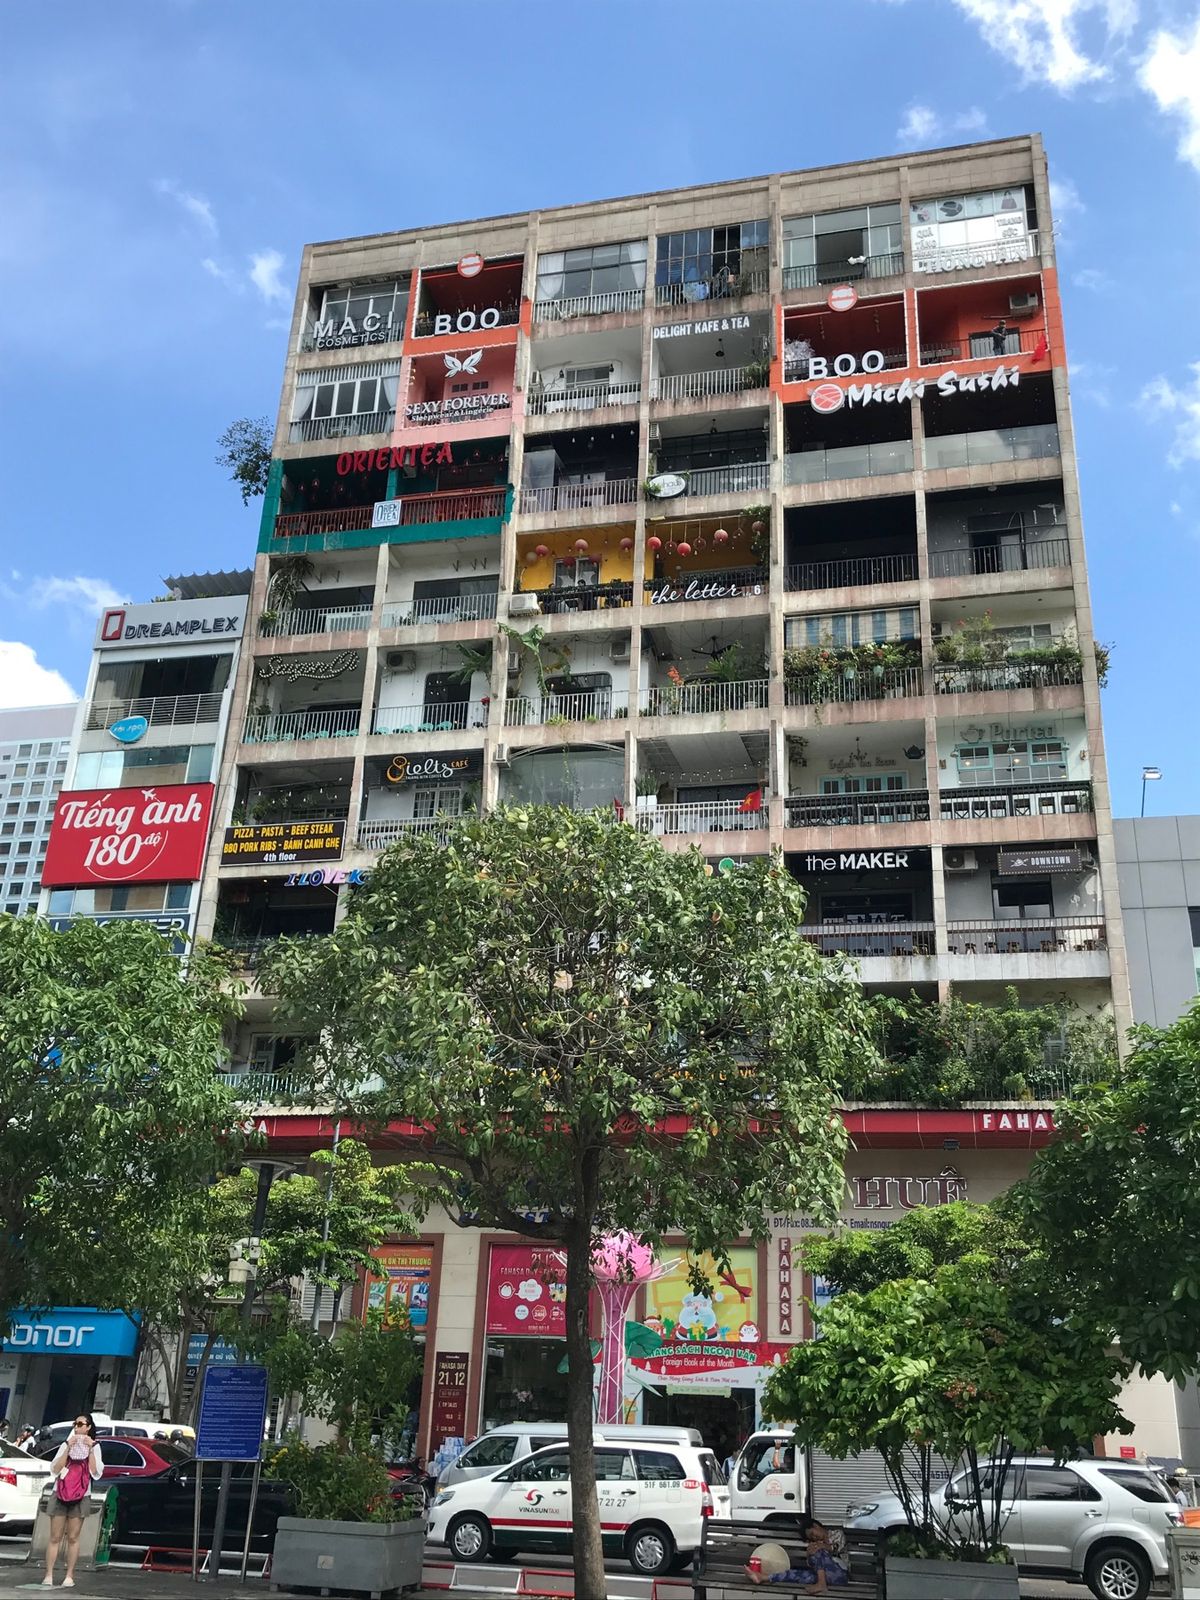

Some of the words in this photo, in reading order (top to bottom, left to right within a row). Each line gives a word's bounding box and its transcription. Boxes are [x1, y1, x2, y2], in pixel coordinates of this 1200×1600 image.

[313, 311, 393, 339] MACI
[434, 308, 500, 335] BOO
[654, 323, 692, 339] DELIGHT
[695, 320, 719, 334] KAFE
[722, 319, 729, 331] &
[731, 316, 750, 329] TEA
[317, 331, 385, 348] COSMETICS
[809, 350, 884, 380] BOO
[848, 377, 925, 408] Michi
[937, 365, 1020, 397] Sushi
[406, 400, 441, 416] SEXY
[444, 392, 509, 412] FOREVER
[336, 441, 454, 476] ORIENTEA
[651, 584, 682, 605] the
[685, 580, 741, 600] letter
[125, 616, 239, 640] DREAMPLEX
[60, 793, 136, 835] Tiếng
[233, 828, 254, 839] PIZZA
[261, 826, 284, 838] PASTA
[291, 825, 310, 836] BEEF
[310, 823, 334, 834] STEAK
[83, 833, 142, 867] 180
[141, 832, 162, 847] độ
[223, 842, 238, 854] BBQ
[239, 841, 259, 853] PORK
[260, 840, 277, 851] RIBS
[283, 837, 303, 851] BÁNH
[304, 838, 324, 849] CANH
[263, 852, 277, 862] 4th
[279, 852, 297, 862] floor
[805, 855, 836, 871] the
[840, 852, 909, 870] MAKER
[1031, 856, 1071, 866] DOWNTOWN
[983, 1113, 1062, 1130] FAHA
[780, 1239, 790, 1332] FAHASA
[3, 1325, 95, 1347] onor
[675, 1342, 701, 1354] SÁCH
[703, 1346, 734, 1359] NGOẠI
[662, 1358, 682, 1368] Foreign
[684, 1358, 698, 1366] Book
[699, 1358, 705, 1366] of
[707, 1358, 716, 1367] the
[717, 1358, 735, 1367] Month
[438, 1371, 466, 1386] 21.12
[604, 1499, 615, 1507] 27
[616, 1499, 627, 1508] 27
